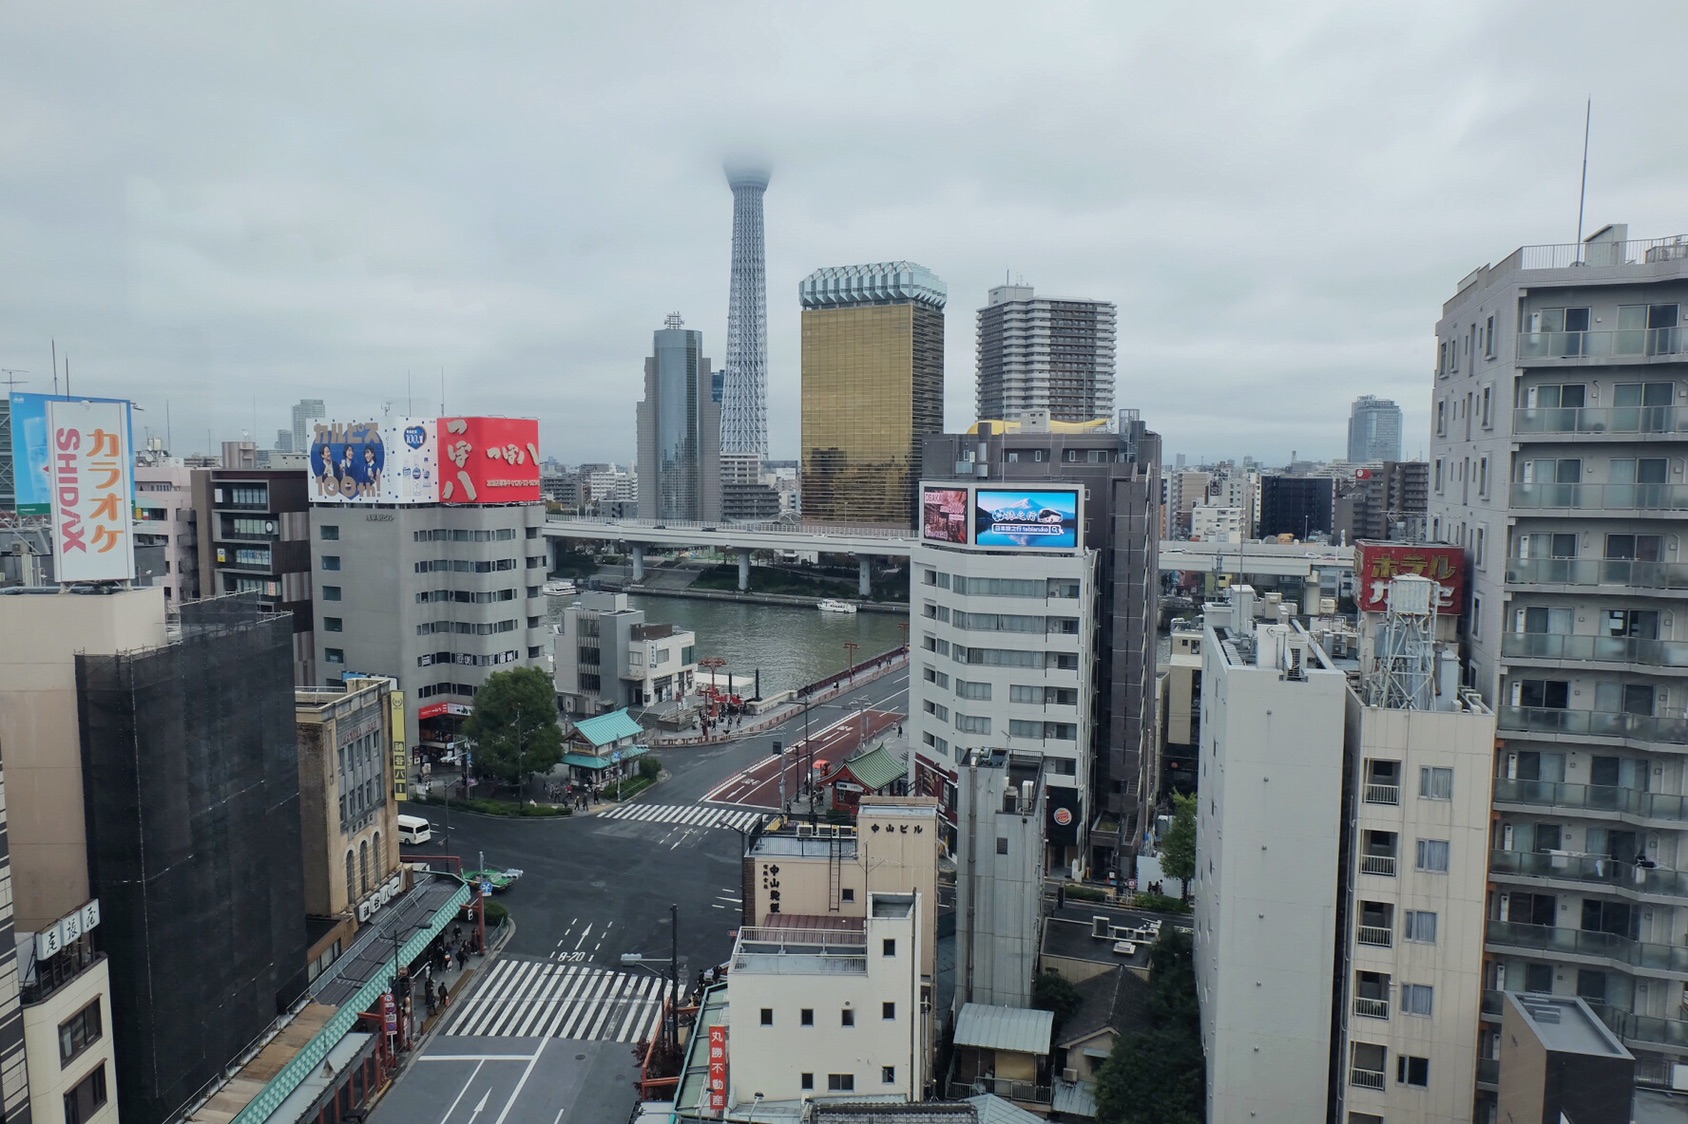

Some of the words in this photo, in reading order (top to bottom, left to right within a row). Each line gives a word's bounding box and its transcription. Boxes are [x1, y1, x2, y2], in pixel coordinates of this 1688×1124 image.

[314, 422, 380, 444] カルピス
[56, 428, 87, 554] SHIDAX
[86, 428, 124, 553] カラオケ
[1372, 553, 1456, 579] ホテル
[394, 742, 406, 793] 神谷バー
[871, 823, 923, 834] 中山ビル
[363, 884, 399, 918] 神谷バー
[557, 951, 586, 962] 8-20
[711, 1031, 724, 1106] 丸勝不動産
